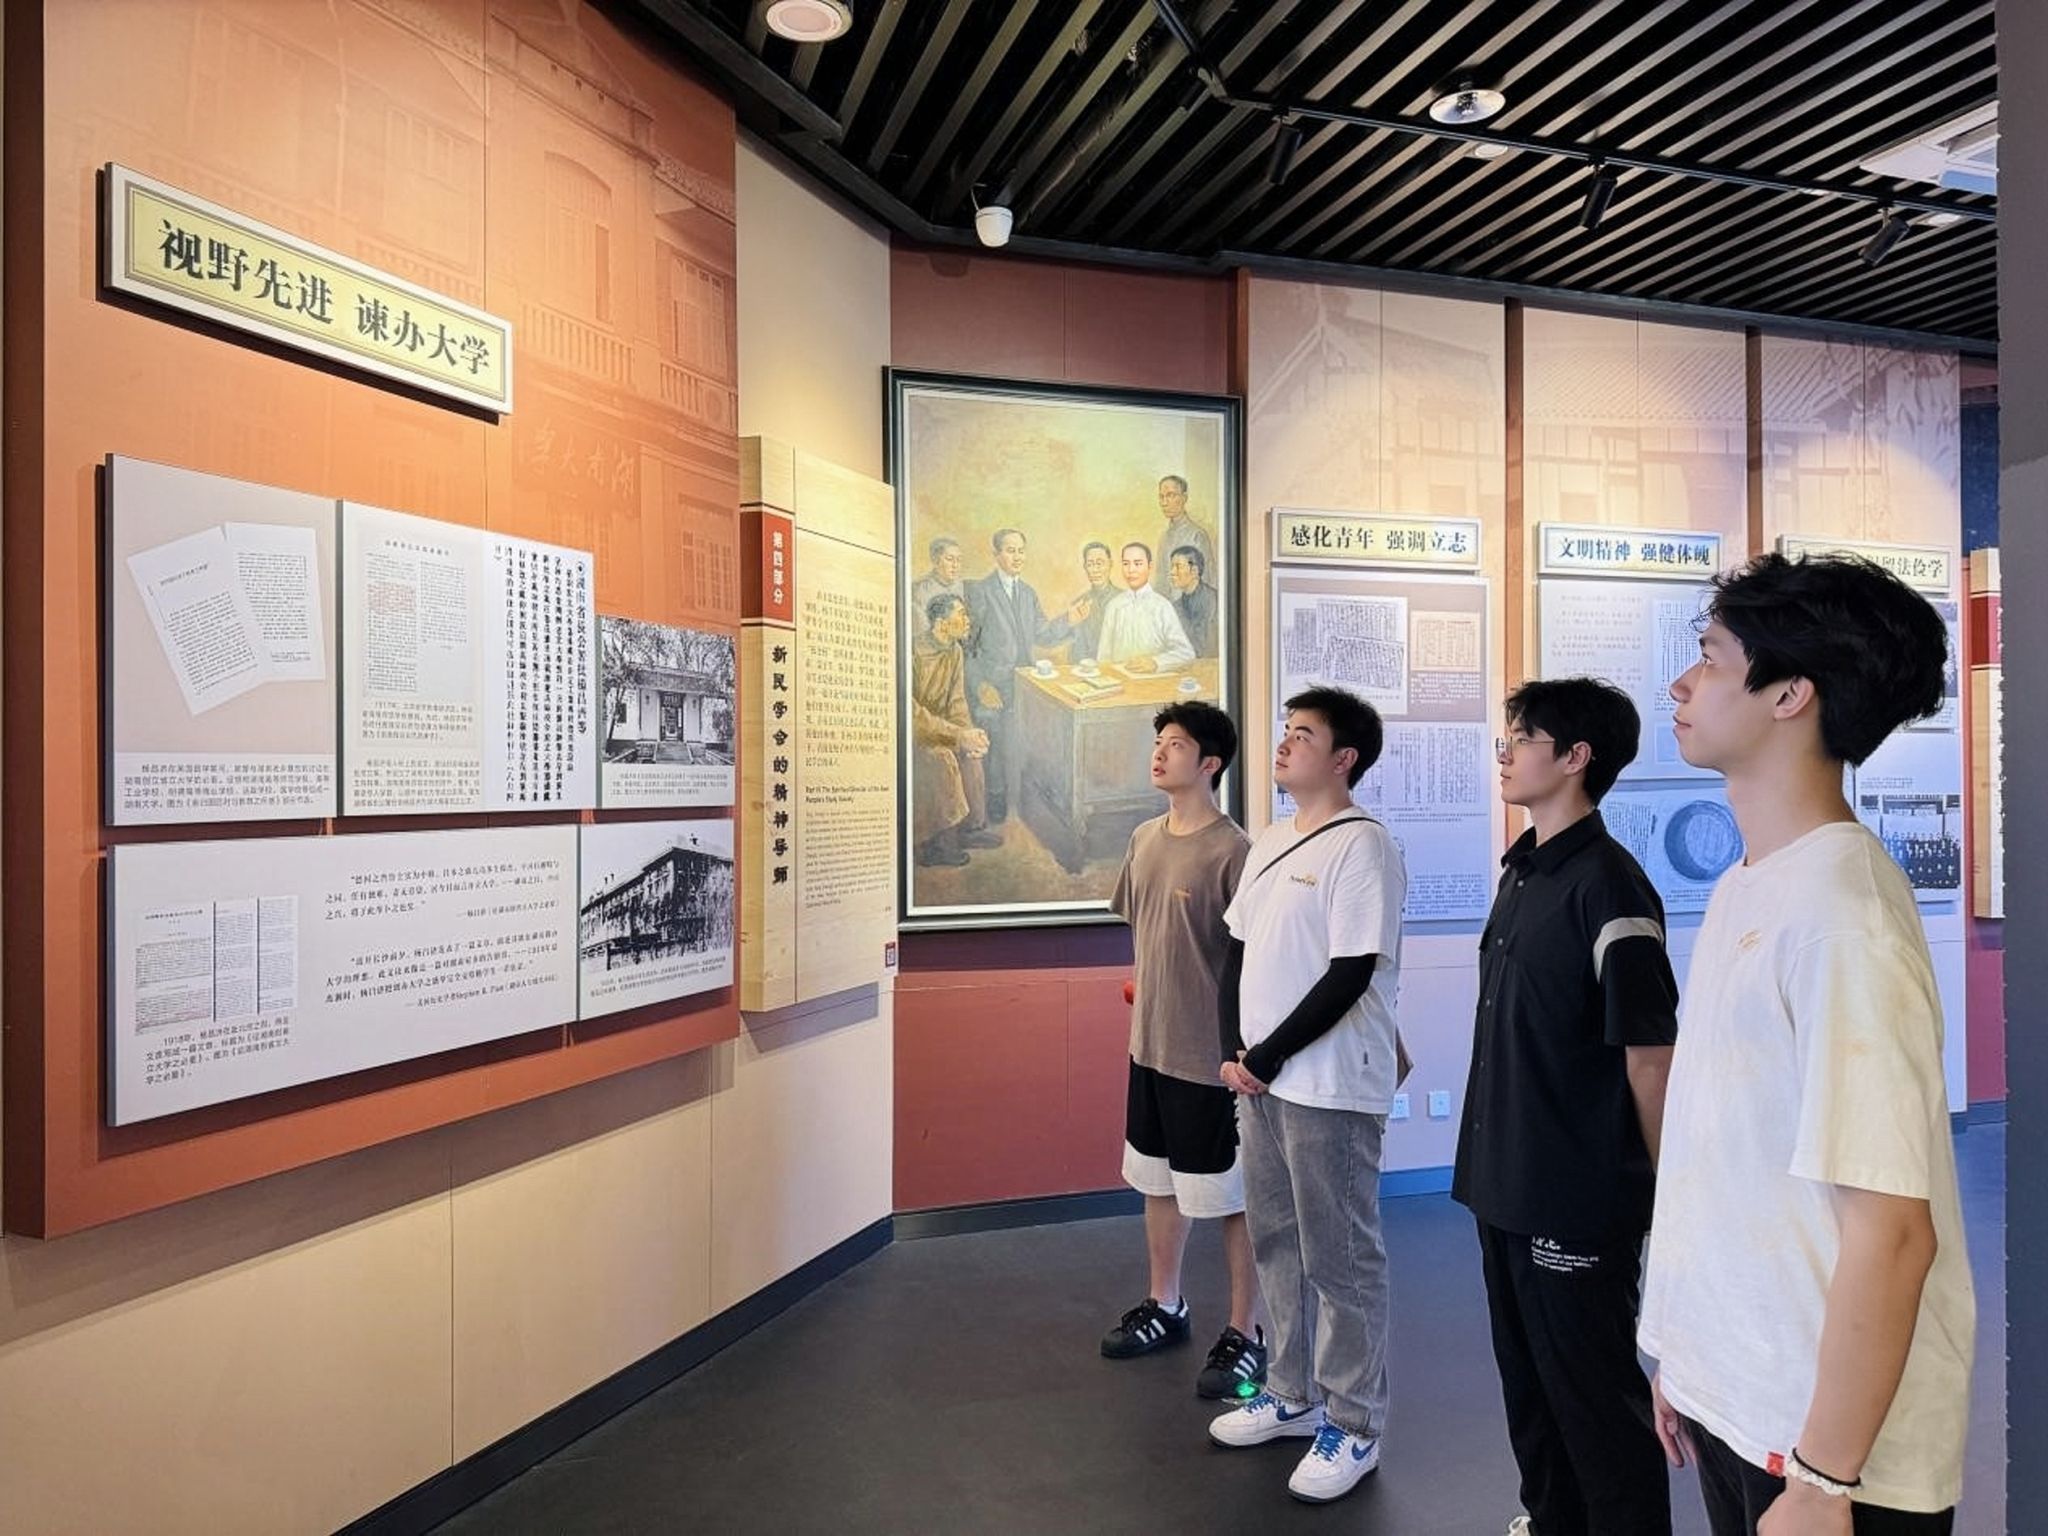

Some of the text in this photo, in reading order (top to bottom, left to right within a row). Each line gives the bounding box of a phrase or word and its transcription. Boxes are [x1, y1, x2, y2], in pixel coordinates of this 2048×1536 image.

[158, 219, 490, 374] 视野先进 谏办大学
[772, 531, 785, 605] 第四部分
[1291, 524, 1467, 553] 感化青年 强调立志
[1559, 538, 1711, 566] 文明精神 强健体魄
[772, 645, 789, 884] 新民学会的精神导师
